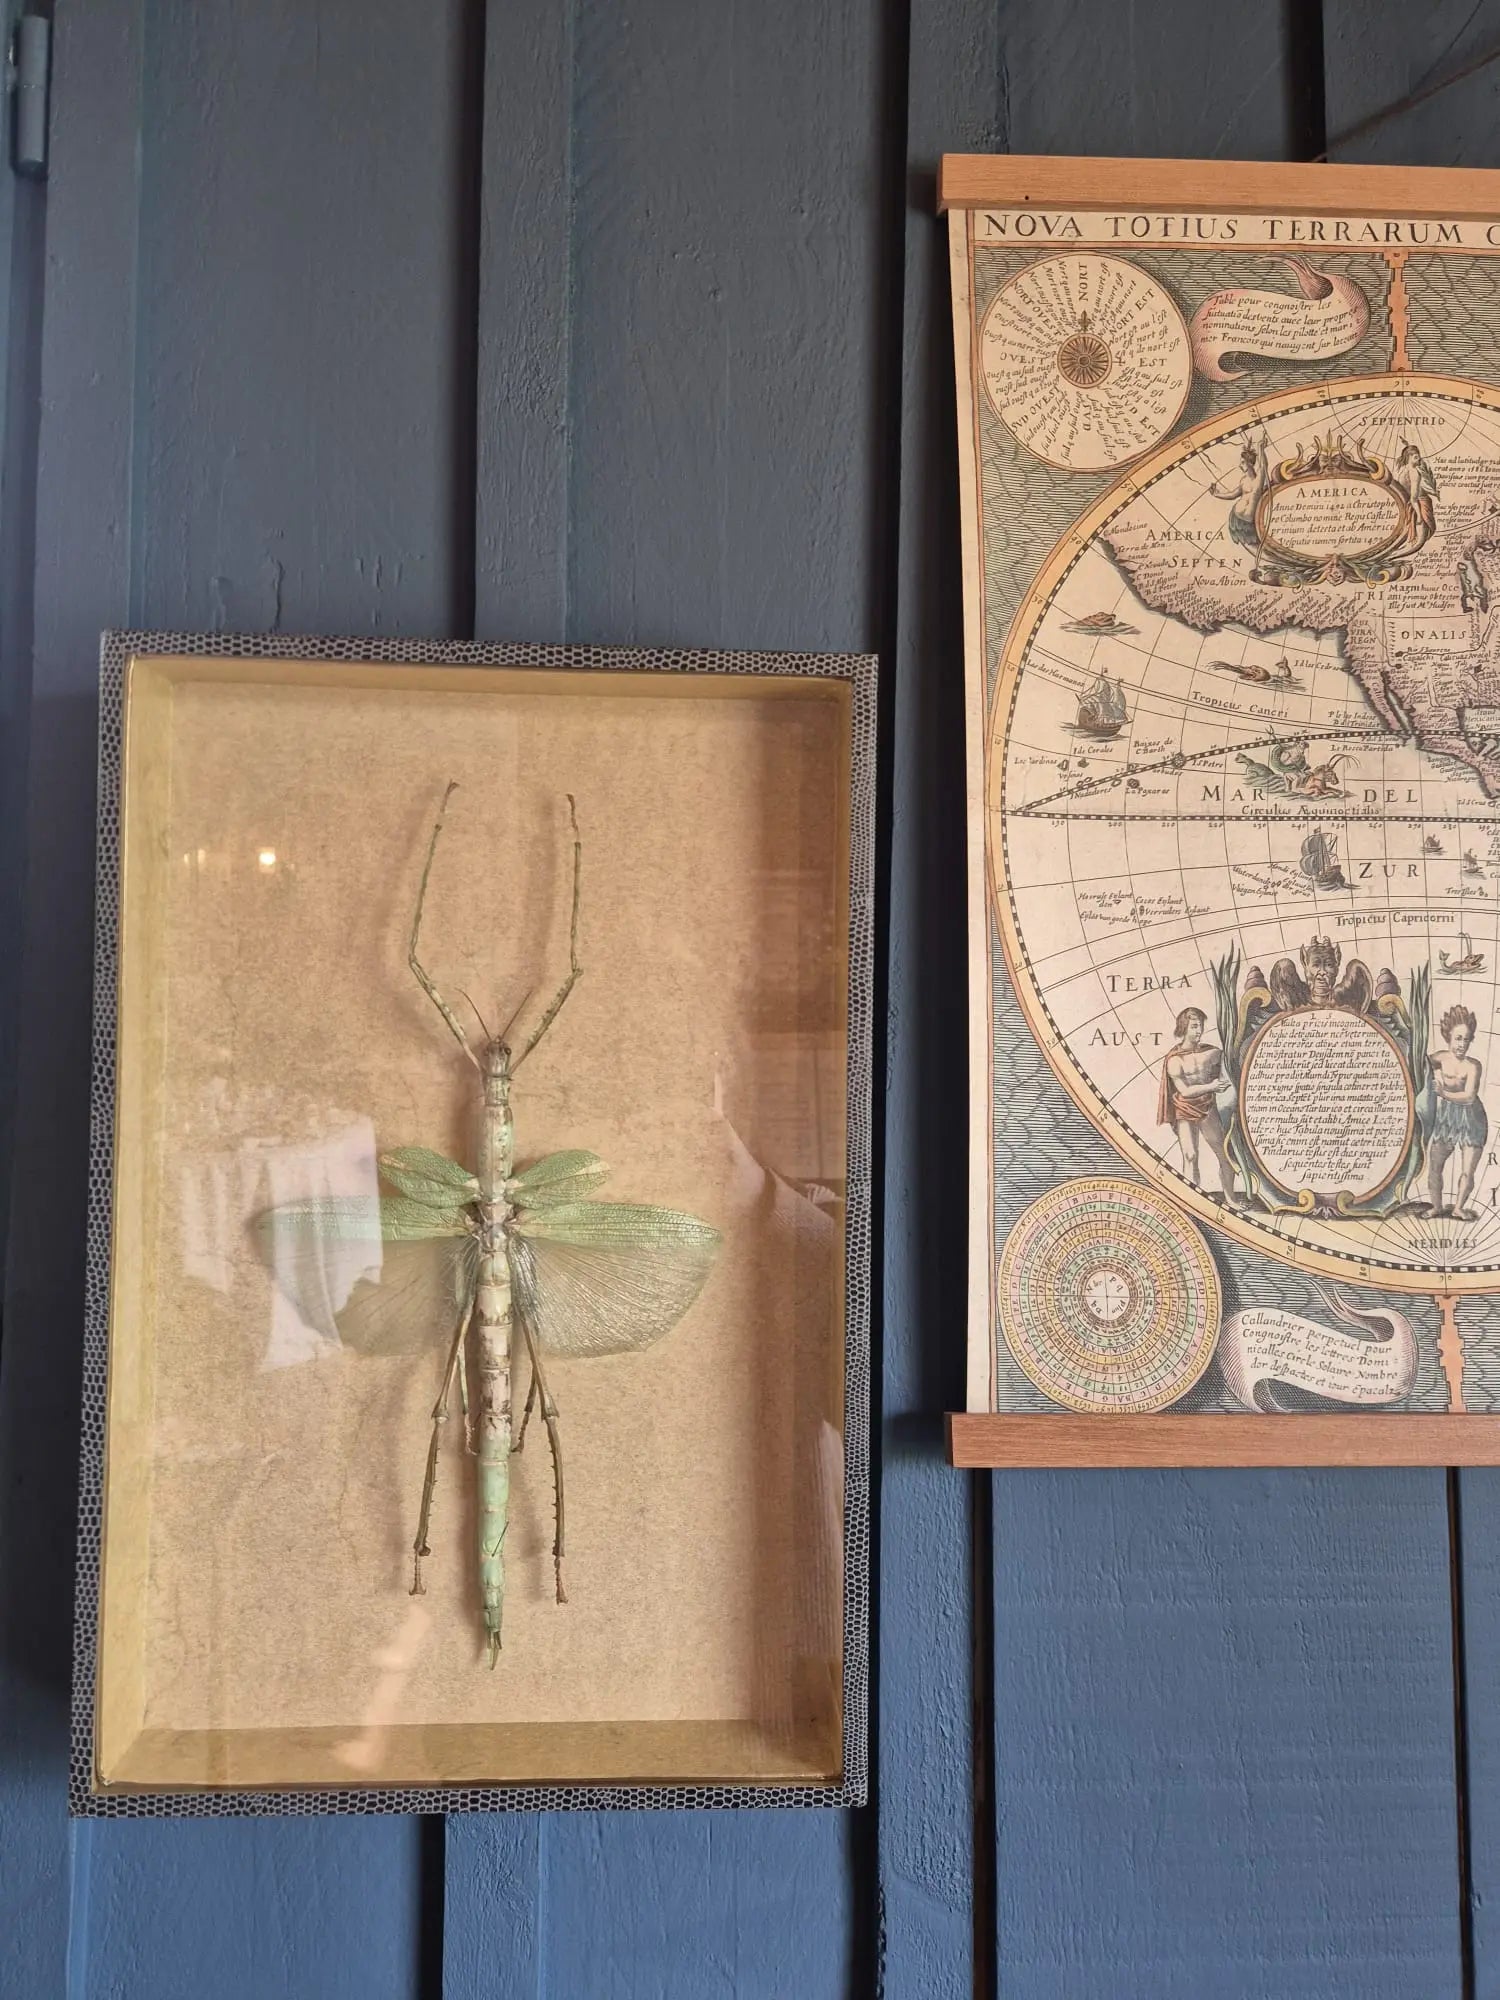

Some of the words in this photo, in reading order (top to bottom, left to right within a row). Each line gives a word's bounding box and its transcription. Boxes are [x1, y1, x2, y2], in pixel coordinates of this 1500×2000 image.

[984, 214, 1083, 237] NOVA
[1105, 216, 1237, 239] TOTIUS
[1263, 219, 1463, 243] TERRARUM
[1238, 297, 1261, 307] pour
[1138, 358, 1167, 367] EST
[1360, 417, 1445, 426] SEPTENTRIO
[1297, 488, 1368, 498] AMERICA
[1145, 530, 1225, 541] AMERICA
[1168, 555, 1242, 568] SEPTEN
[1401, 631, 1466, 640] ONALIS
[1192, 692, 1242, 710] Tropicus
[1250, 705, 1289, 718] Cancri
[1202, 785, 1266, 801] MAR
[1364, 789, 1418, 802] DEL
[1359, 863, 1419, 878] ZUR
[1335, 913, 1386, 927] Tropicus
[1393, 912, 1455, 925] Capricorni
[1107, 974, 1192, 992] TERRA
[1088, 1027, 1163, 1046] AUST
[1365, 1346, 1392, 1356] pour
